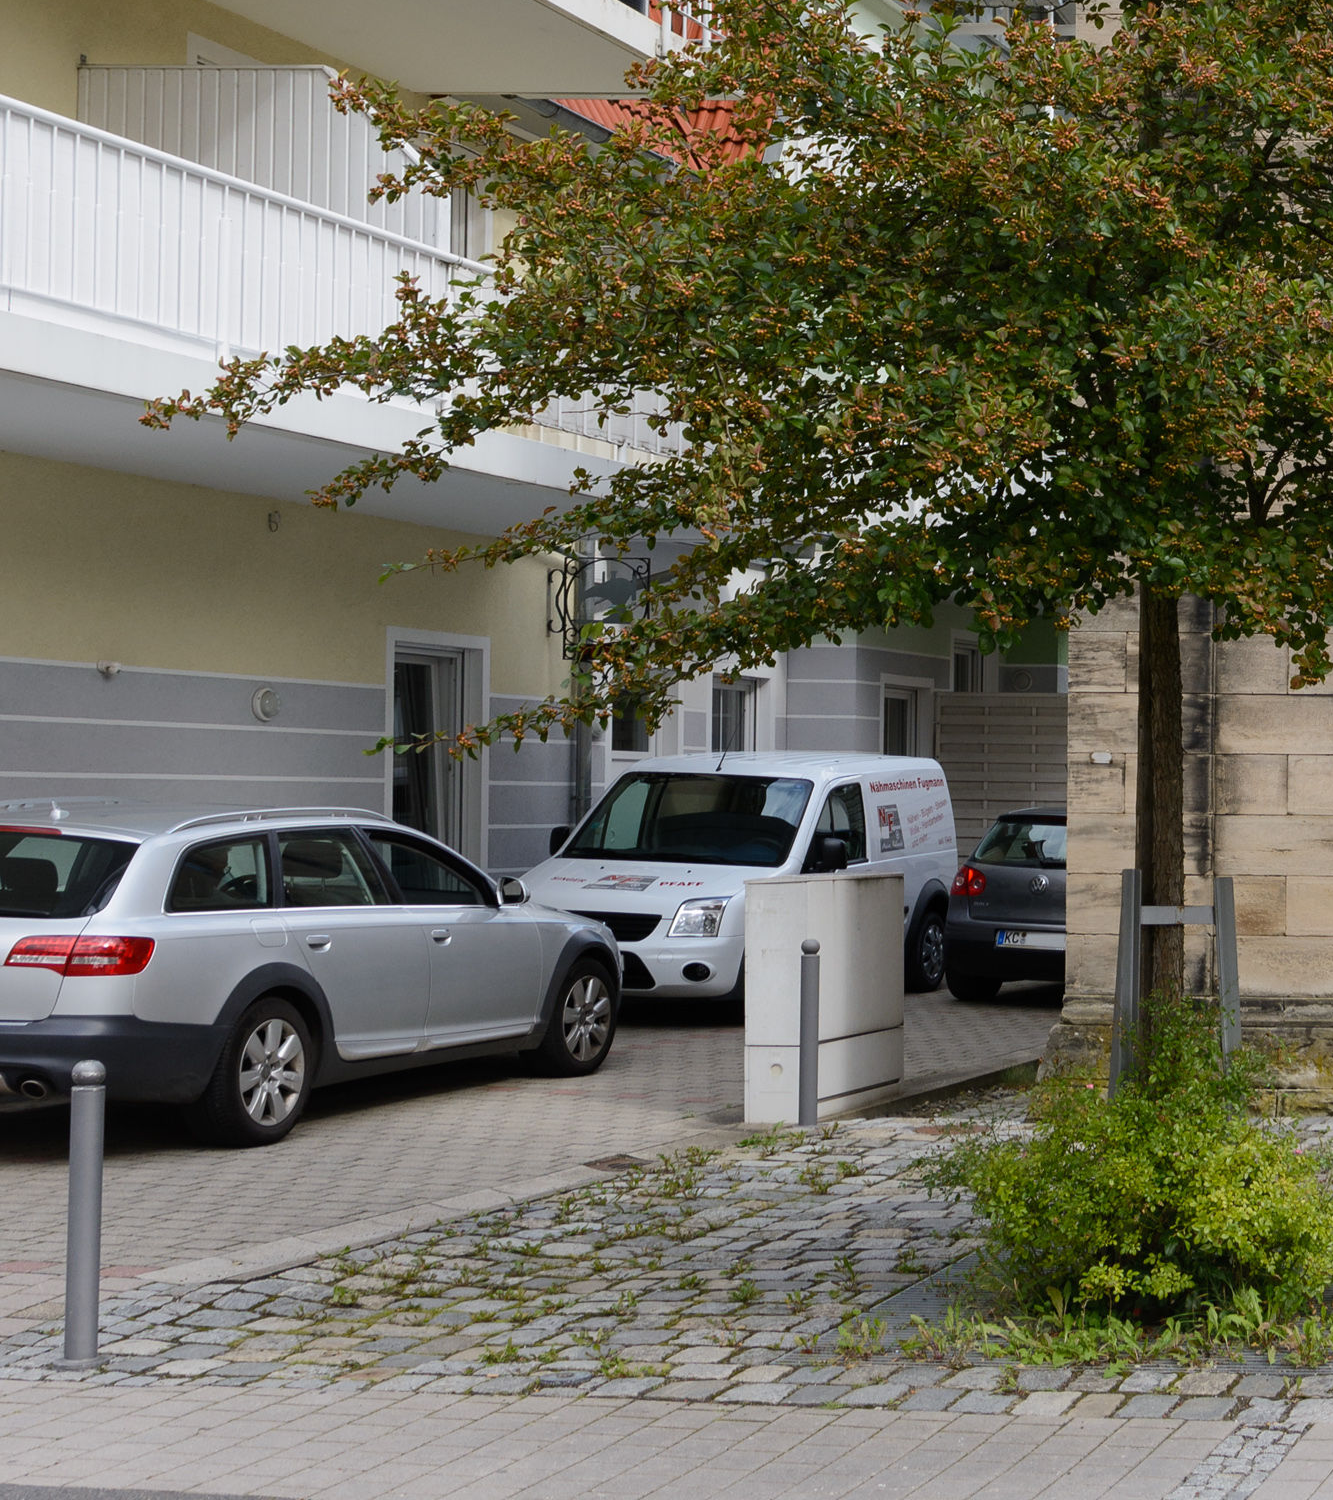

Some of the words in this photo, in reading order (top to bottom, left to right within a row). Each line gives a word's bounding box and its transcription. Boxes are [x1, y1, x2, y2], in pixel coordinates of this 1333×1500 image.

[869, 778, 917, 793] Nähmaschinen
[917, 777, 944, 791] Fugmann
[1004, 932, 1020, 944] KC
